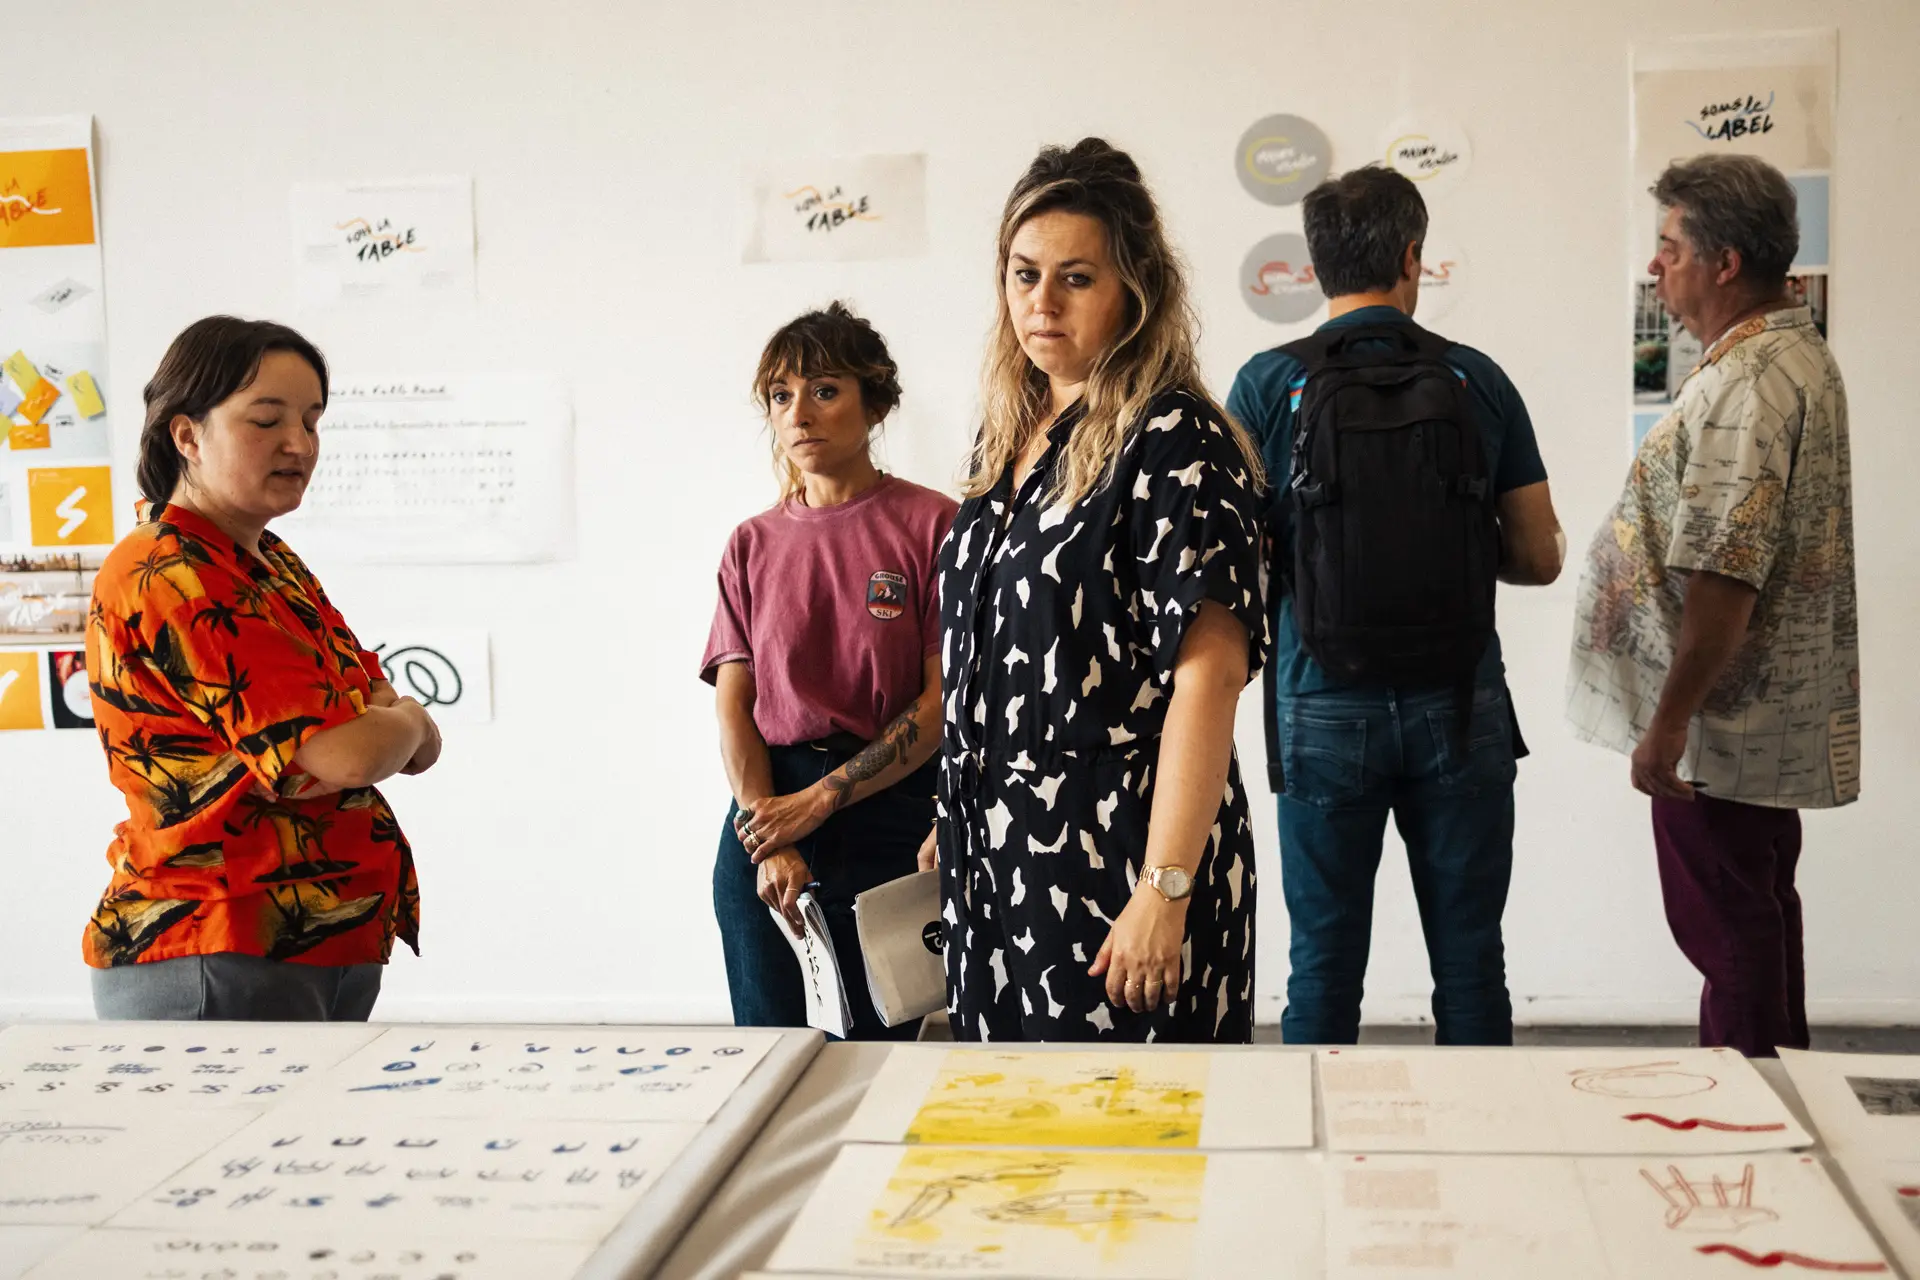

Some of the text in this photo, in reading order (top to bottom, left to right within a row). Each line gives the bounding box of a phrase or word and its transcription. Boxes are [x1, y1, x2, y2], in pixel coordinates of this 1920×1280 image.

[1706, 114, 1774, 142] LABEL
[805, 195, 869, 232] TABLE
[356, 228, 417, 263] TABLE
[876, 608, 893, 618] SKI
